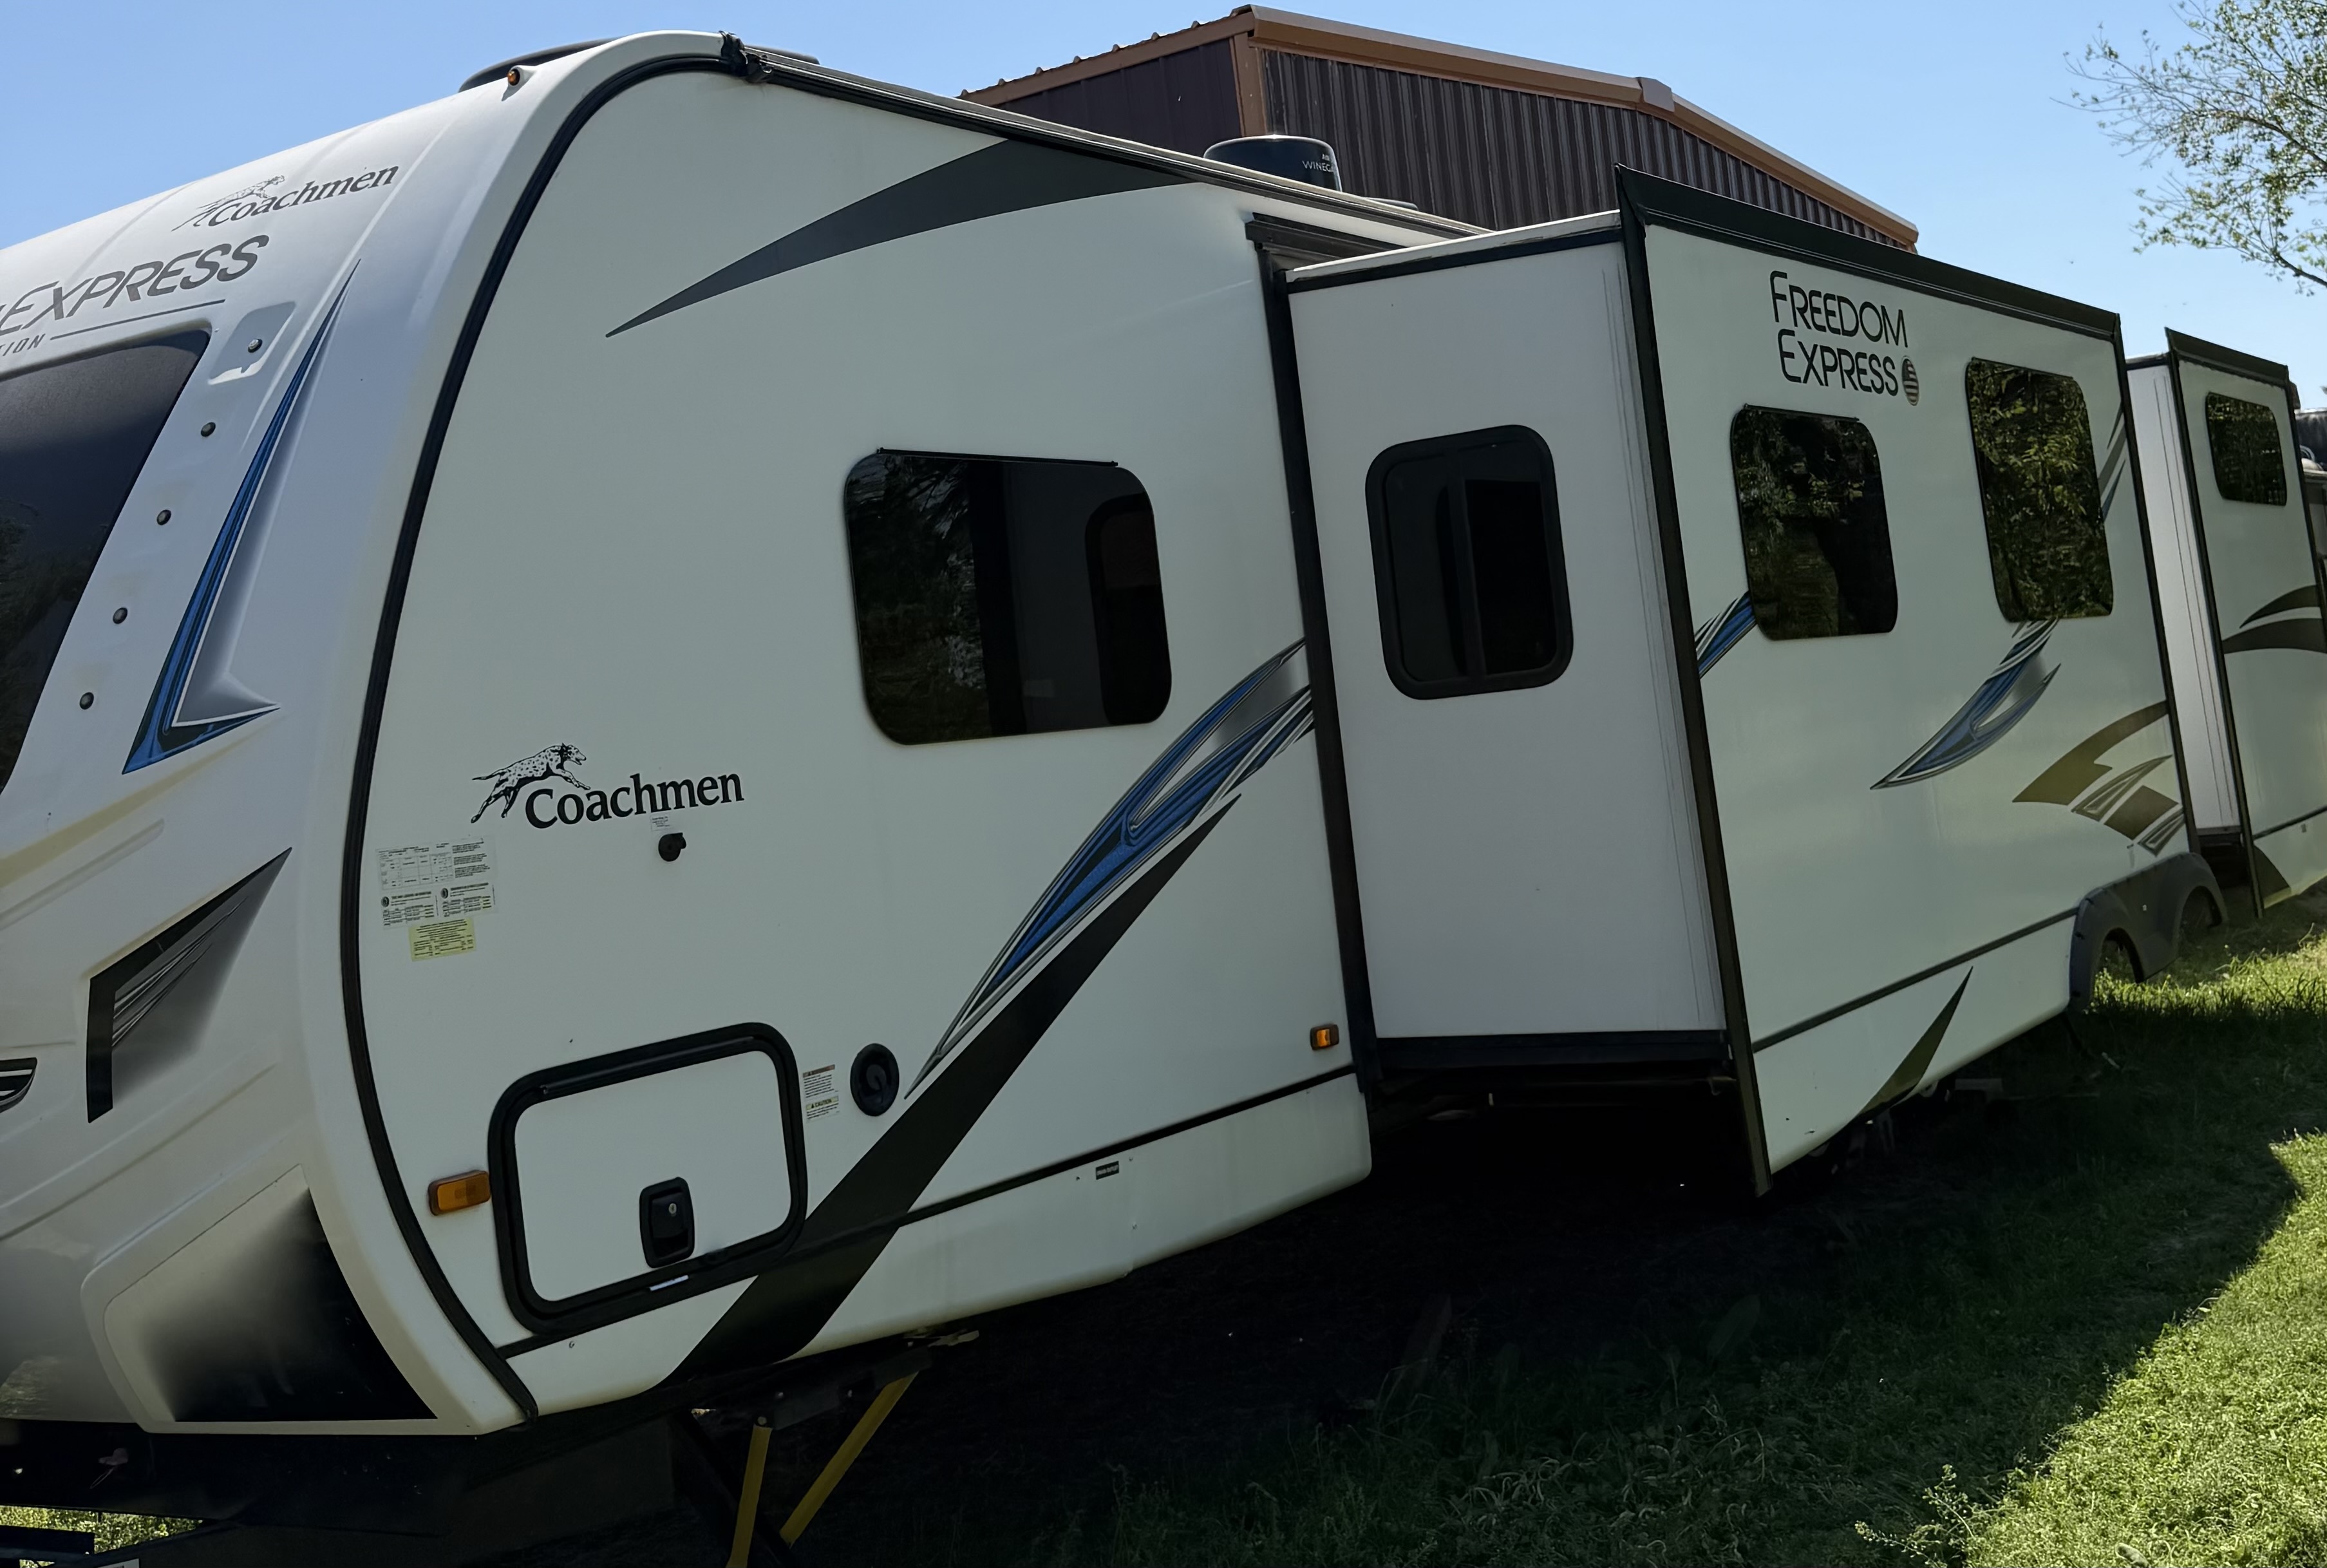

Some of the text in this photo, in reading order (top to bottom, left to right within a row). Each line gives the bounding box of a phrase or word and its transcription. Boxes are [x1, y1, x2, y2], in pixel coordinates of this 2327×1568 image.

[207, 165, 399, 227] Coachmen
[0, 234, 269, 335] EXPRESS
[1769, 270, 1908, 348] FREEDOM
[1777, 328, 1899, 397] EXPRESS
[525, 773, 745, 829] Coachmen
